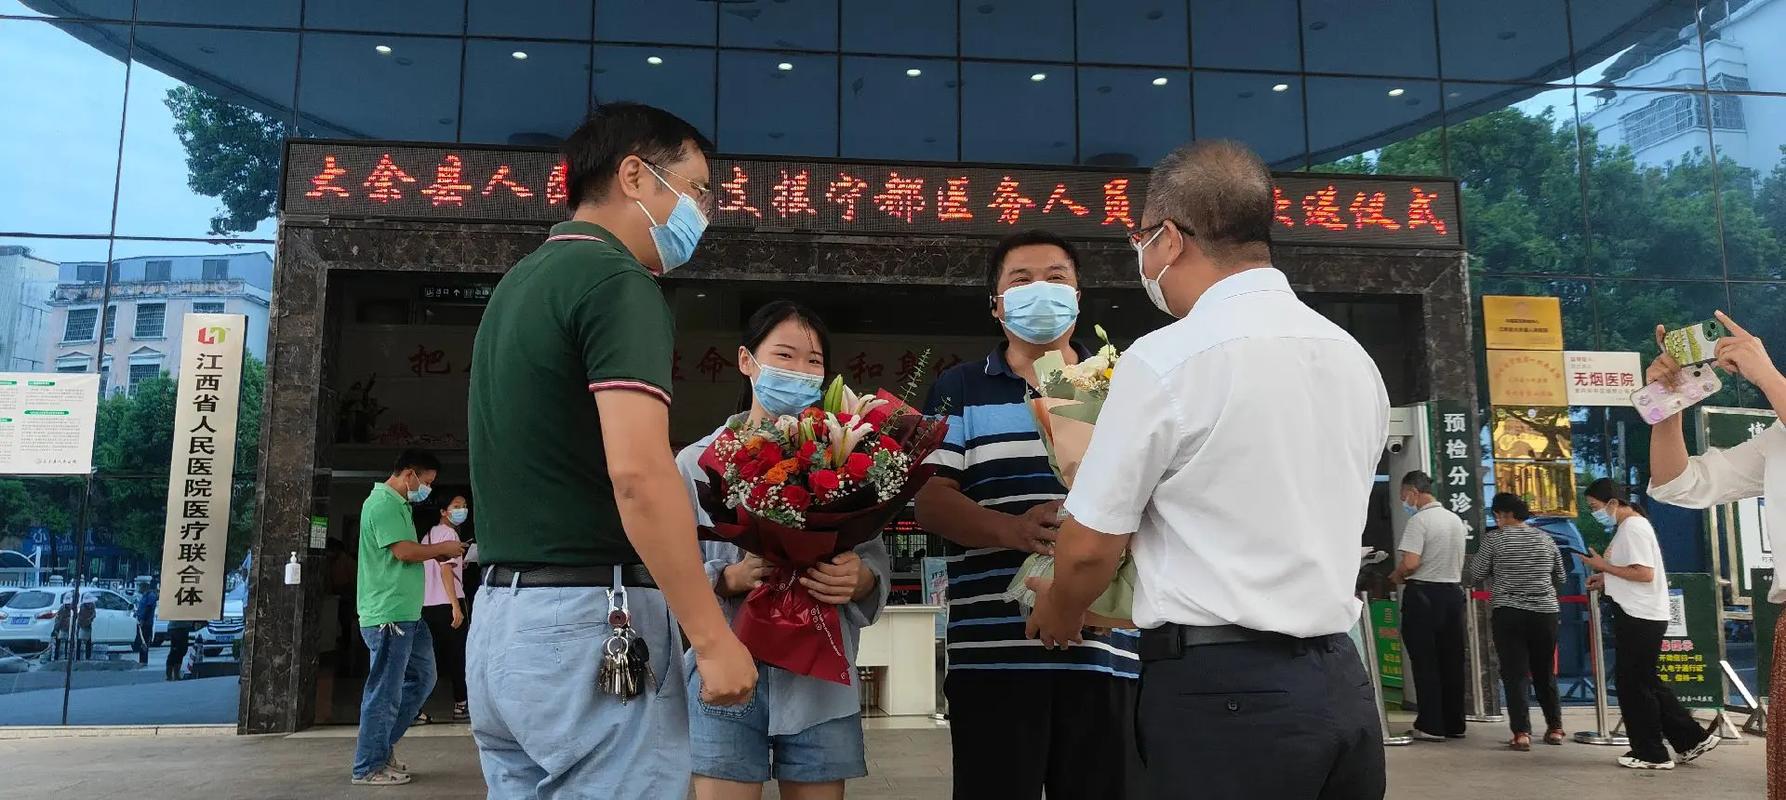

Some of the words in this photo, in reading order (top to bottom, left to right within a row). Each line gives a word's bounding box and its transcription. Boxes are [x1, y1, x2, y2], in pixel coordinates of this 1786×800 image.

[1573, 371, 1635, 387] 无烟医院
[174, 353, 223, 606] 江西省人民医院医疗联合体
